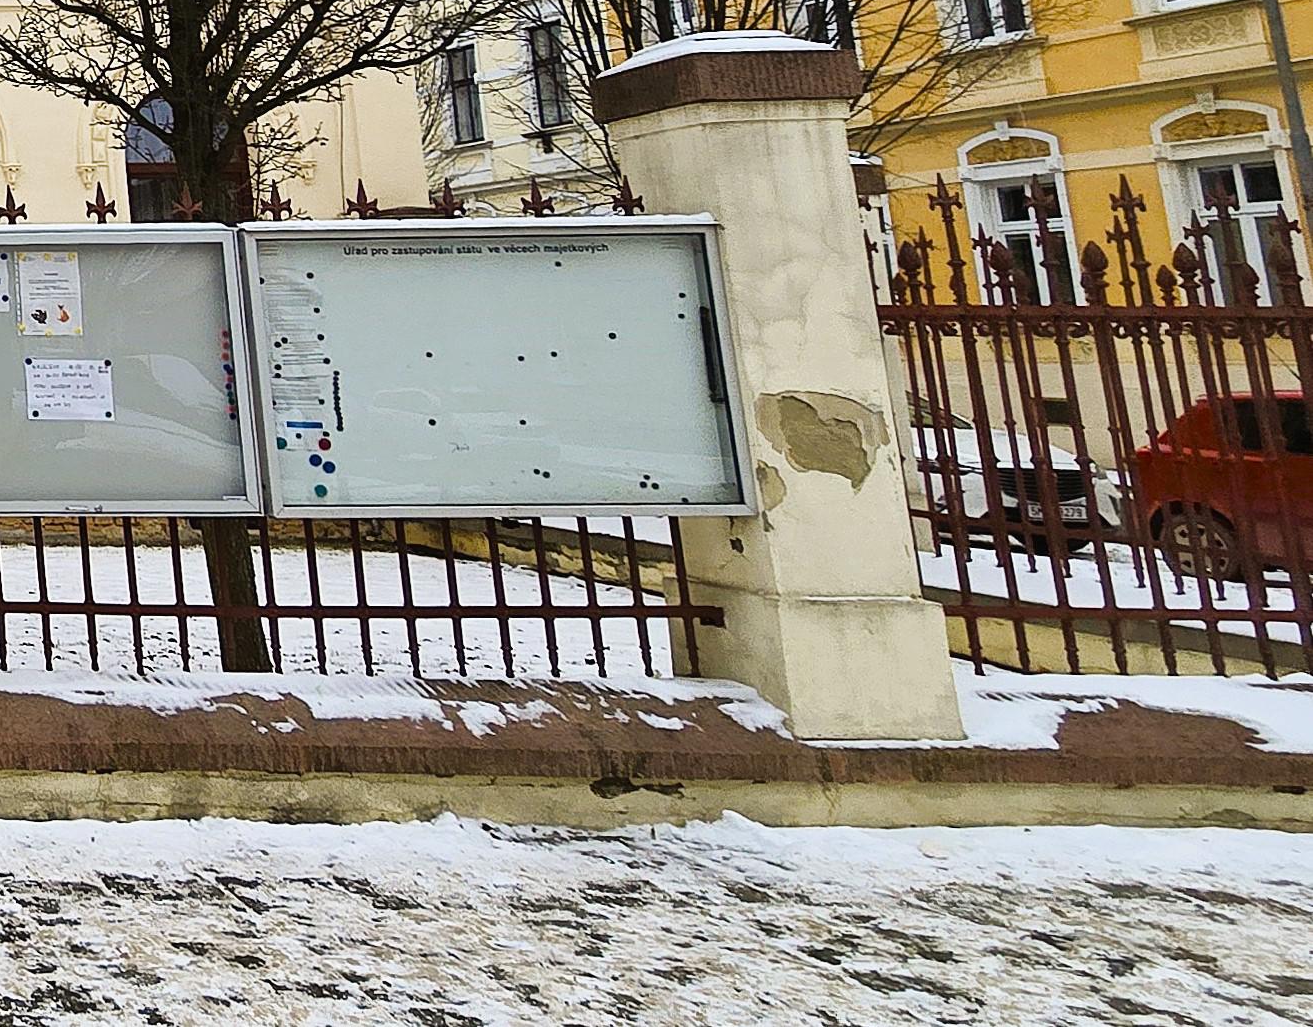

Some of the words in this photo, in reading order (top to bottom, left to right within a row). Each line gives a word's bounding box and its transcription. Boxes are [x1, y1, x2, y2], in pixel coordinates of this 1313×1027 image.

[371, 248, 389, 256] pro
[391, 246, 453, 256] zastupování
[544, 242, 609, 254] majetkových
